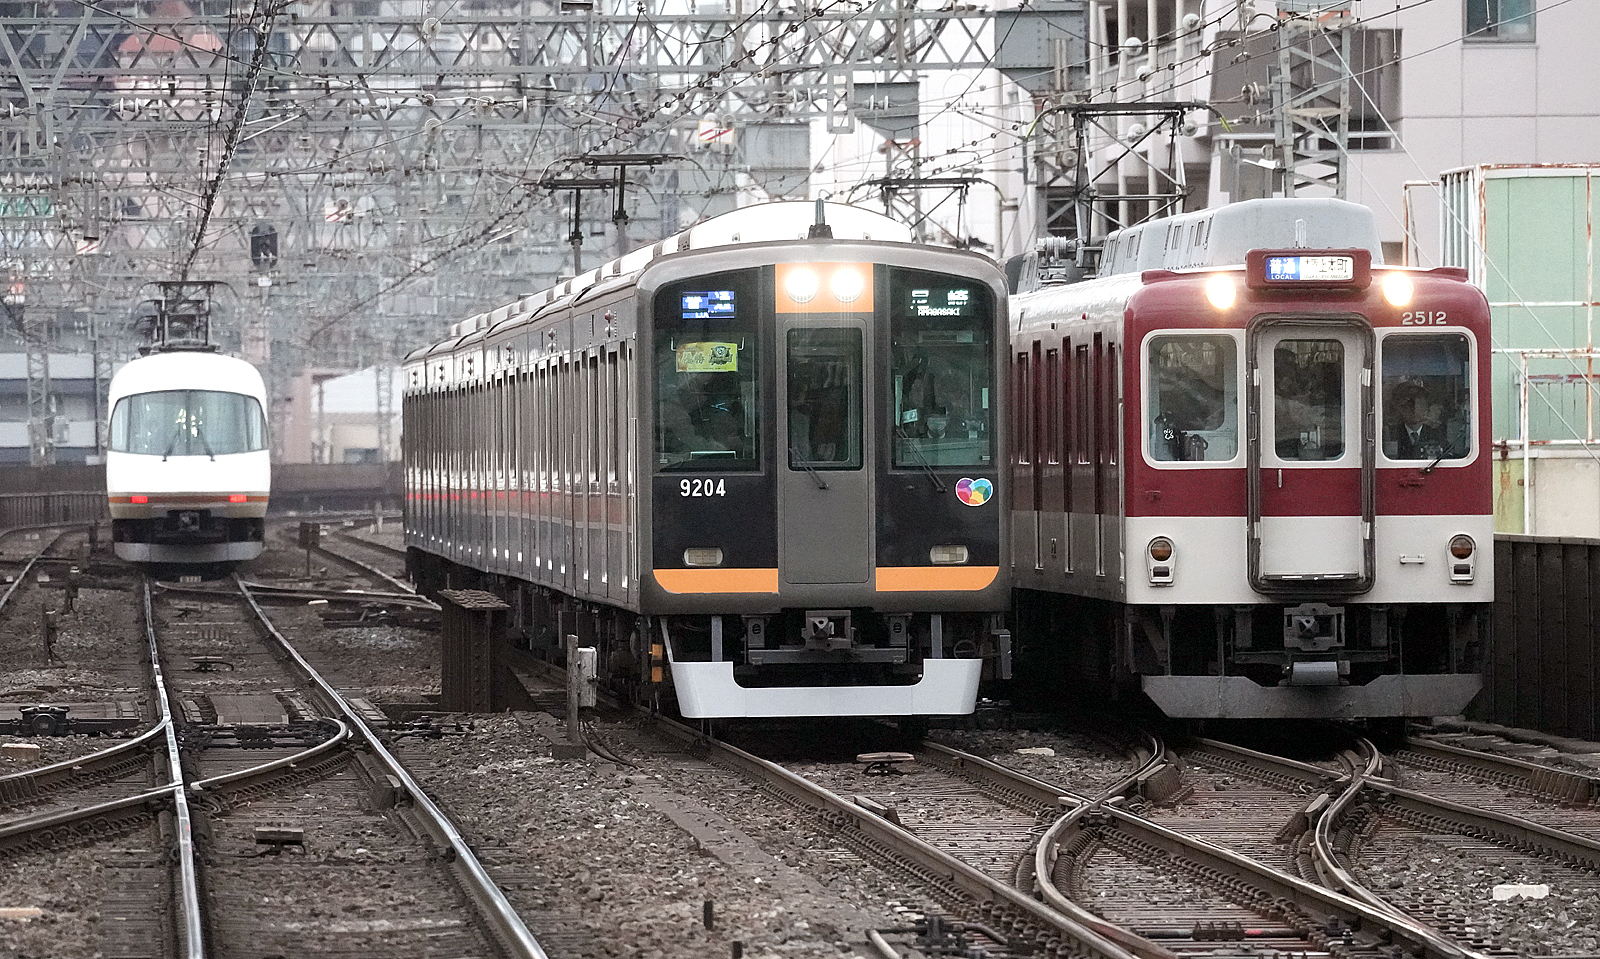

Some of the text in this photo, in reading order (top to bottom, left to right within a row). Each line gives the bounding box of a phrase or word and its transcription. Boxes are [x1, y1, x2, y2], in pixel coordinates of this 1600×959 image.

[1270, 258, 1296, 274] 普通
[1402, 311, 1447, 325] 2512
[680, 478, 727, 497] 9204
